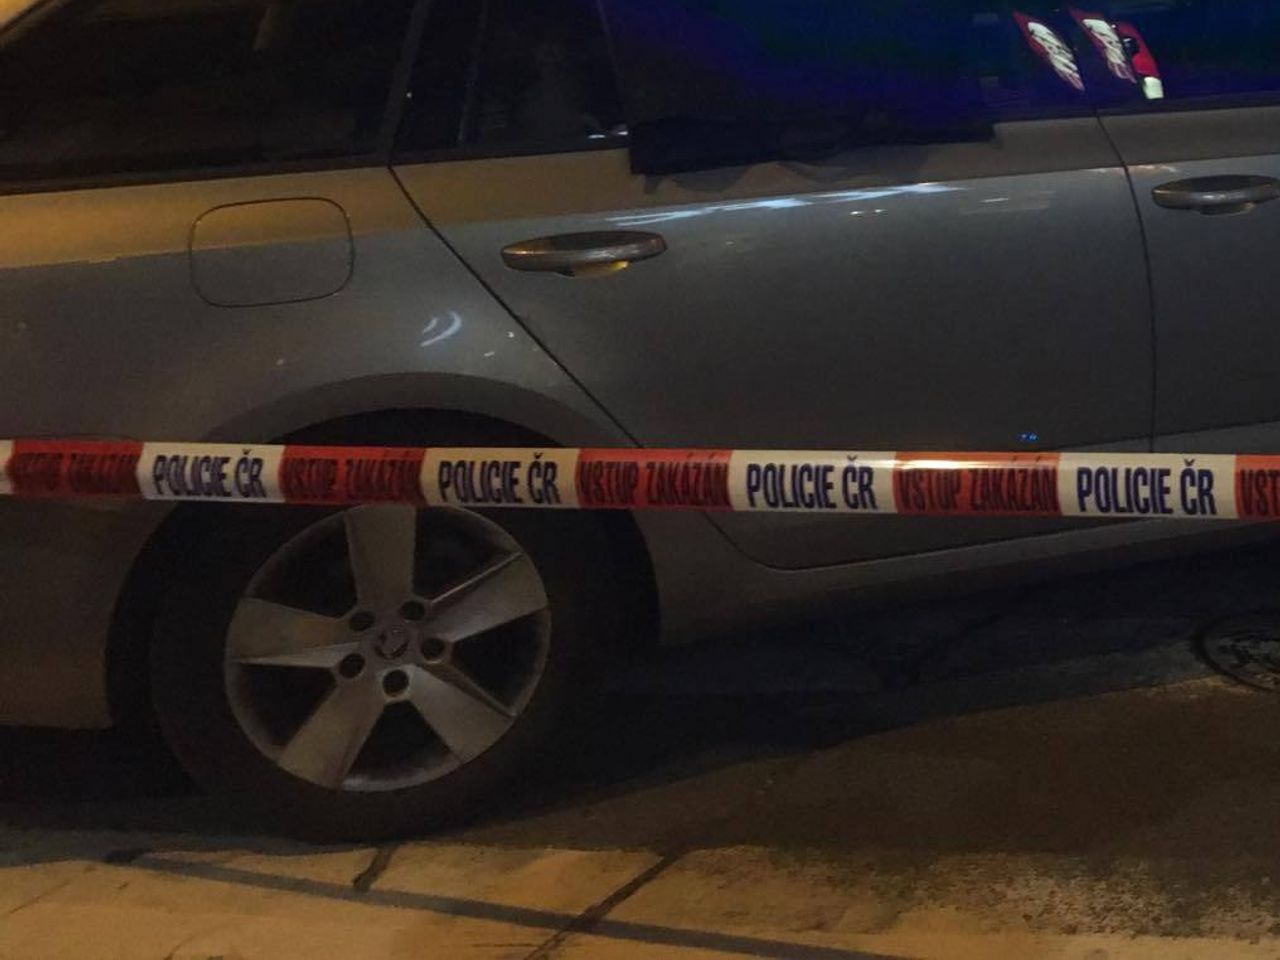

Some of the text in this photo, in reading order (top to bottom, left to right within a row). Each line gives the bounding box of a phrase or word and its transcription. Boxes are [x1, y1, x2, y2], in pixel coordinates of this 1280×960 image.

[153, 455, 231, 497] POLICIE
[235, 449, 266, 498] ČR
[438, 453, 562, 504] POLICIE ČR
[746, 455, 877, 509] POLICIE ČR
[1077, 459, 1217, 515] POLICIE ČR
